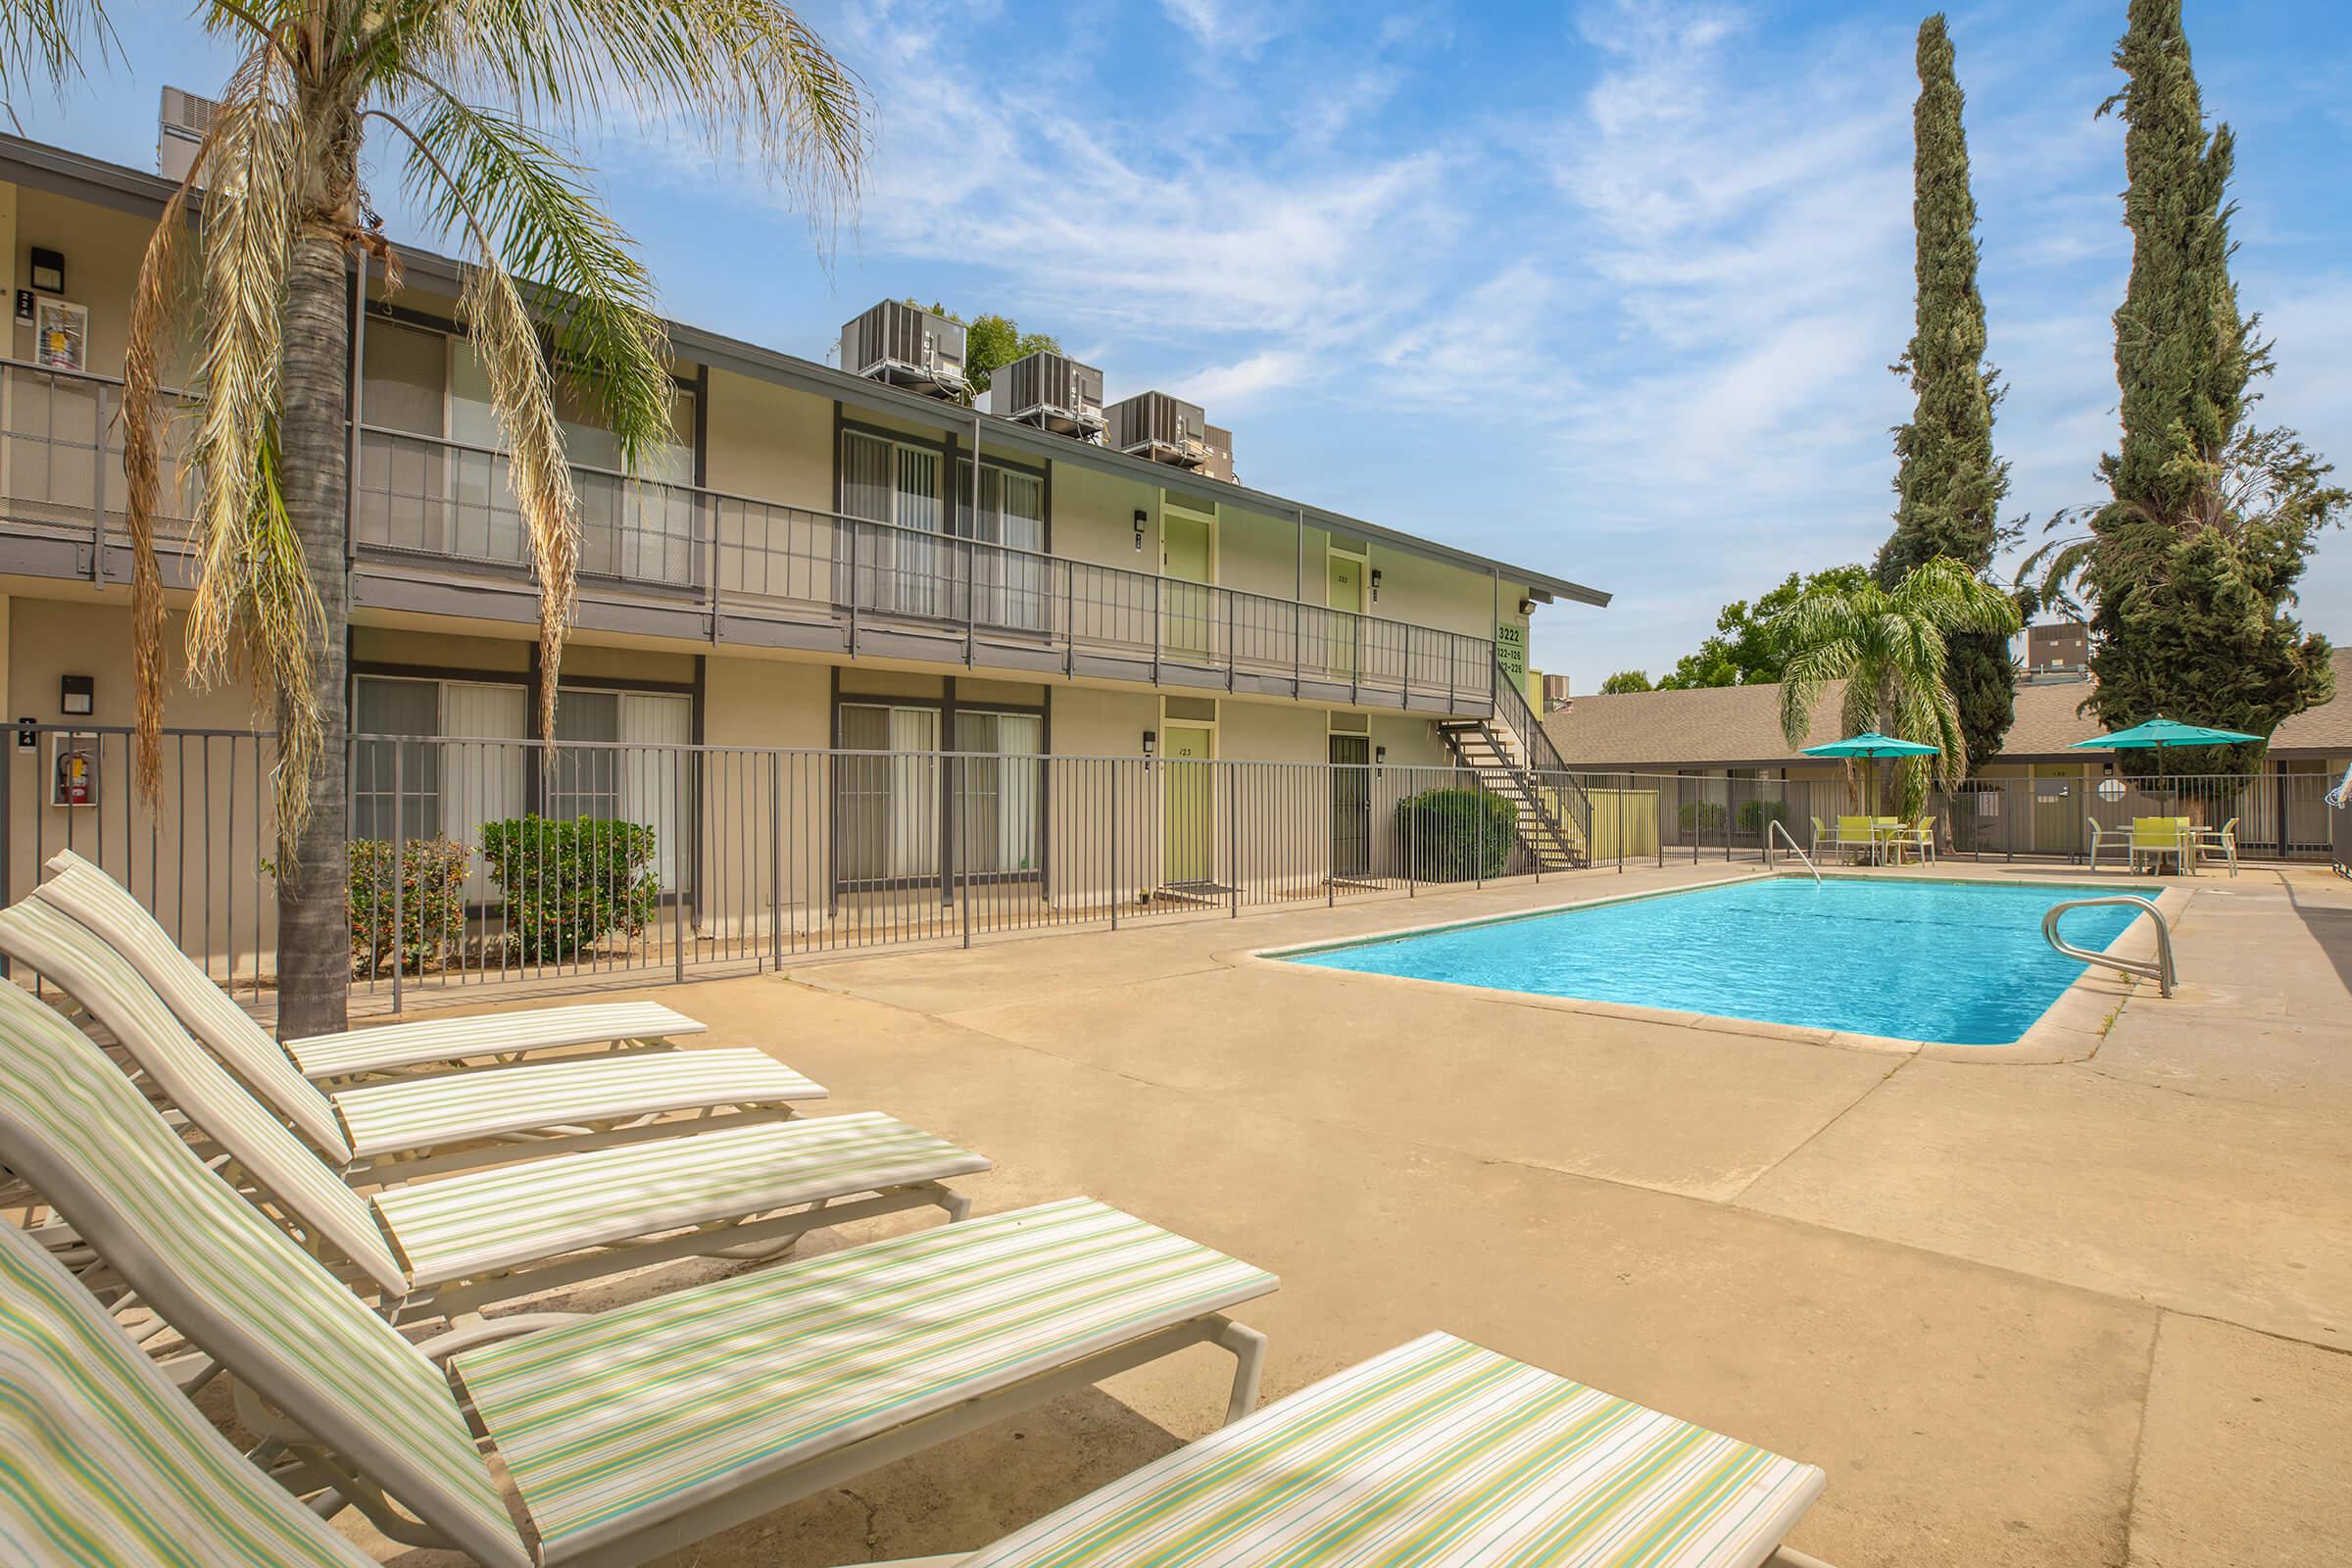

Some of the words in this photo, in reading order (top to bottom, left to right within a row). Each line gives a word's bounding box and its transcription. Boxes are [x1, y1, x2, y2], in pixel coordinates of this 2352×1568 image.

[1498, 626, 1520, 642] 3222
[1496, 647, 1521, 661] 122-126
[1179, 748, 1192, 757] 123
